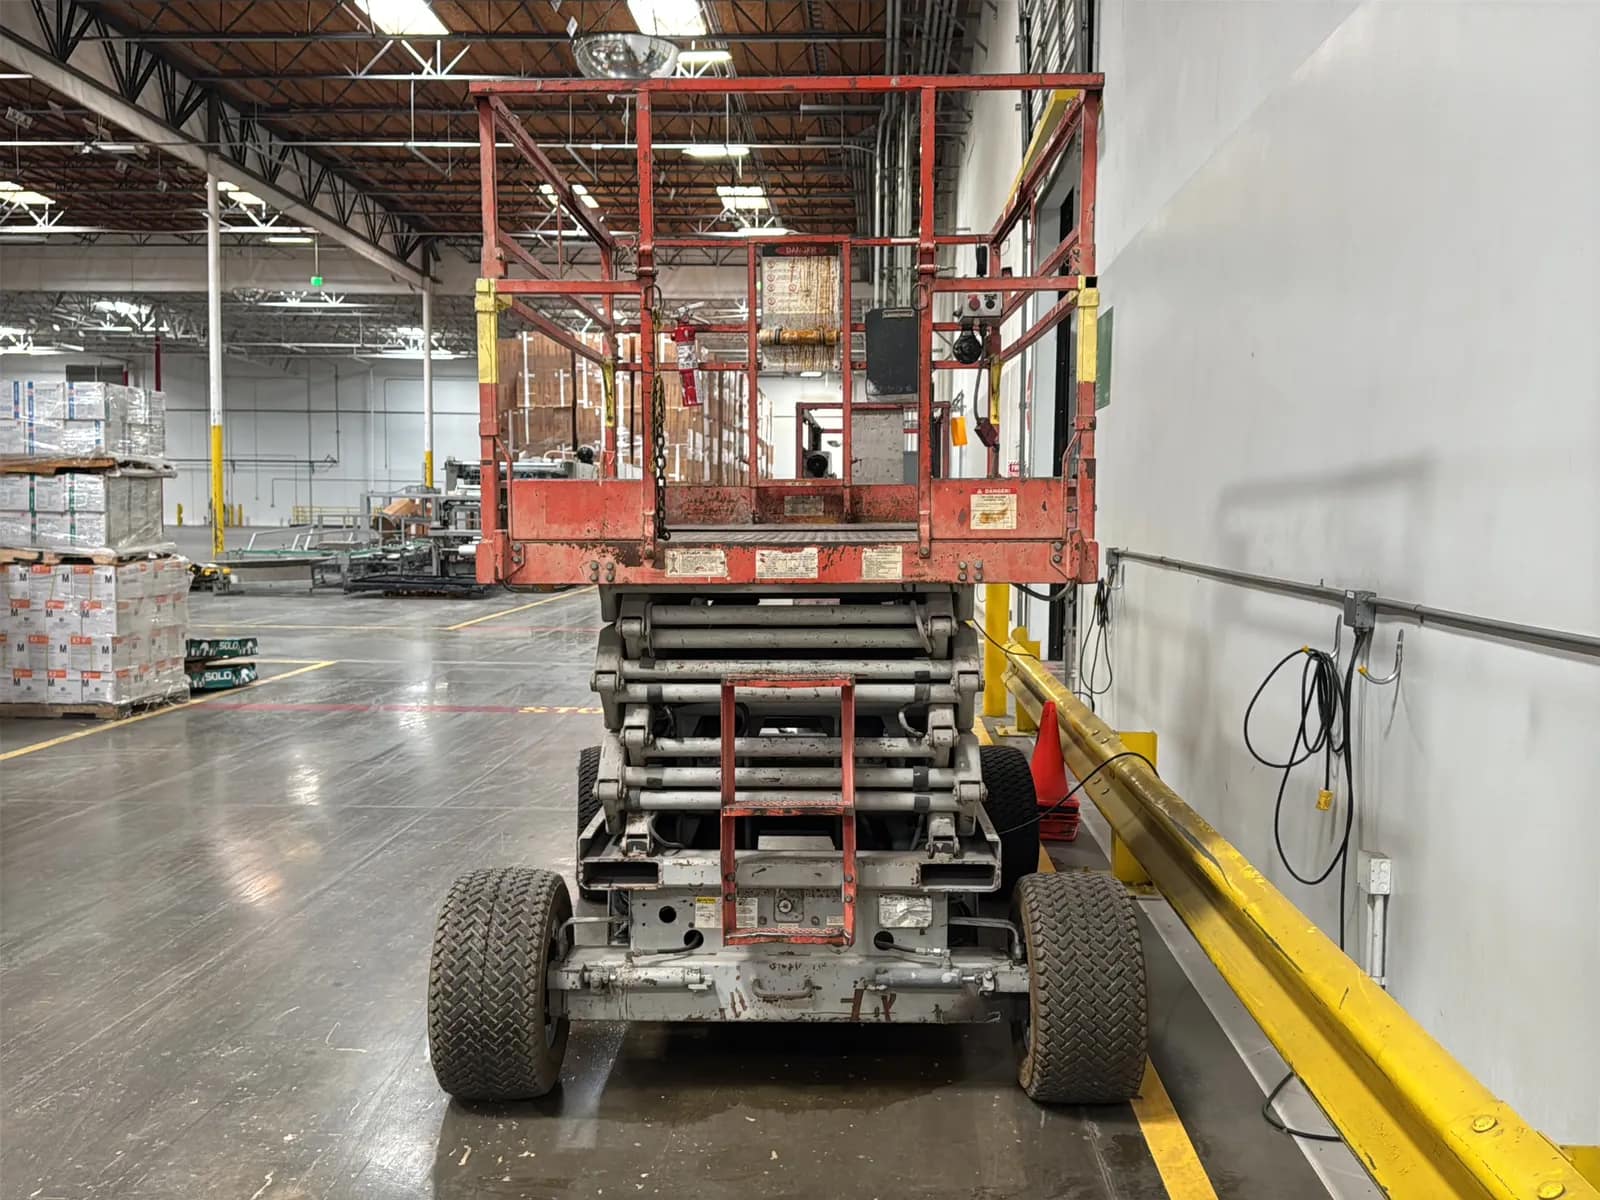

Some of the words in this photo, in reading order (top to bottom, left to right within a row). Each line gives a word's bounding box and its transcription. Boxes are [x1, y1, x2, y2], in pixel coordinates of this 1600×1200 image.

[105, 574, 112, 584] M
[219, 641, 239, 650] SOLO
[205, 671, 232, 681] SOLO
